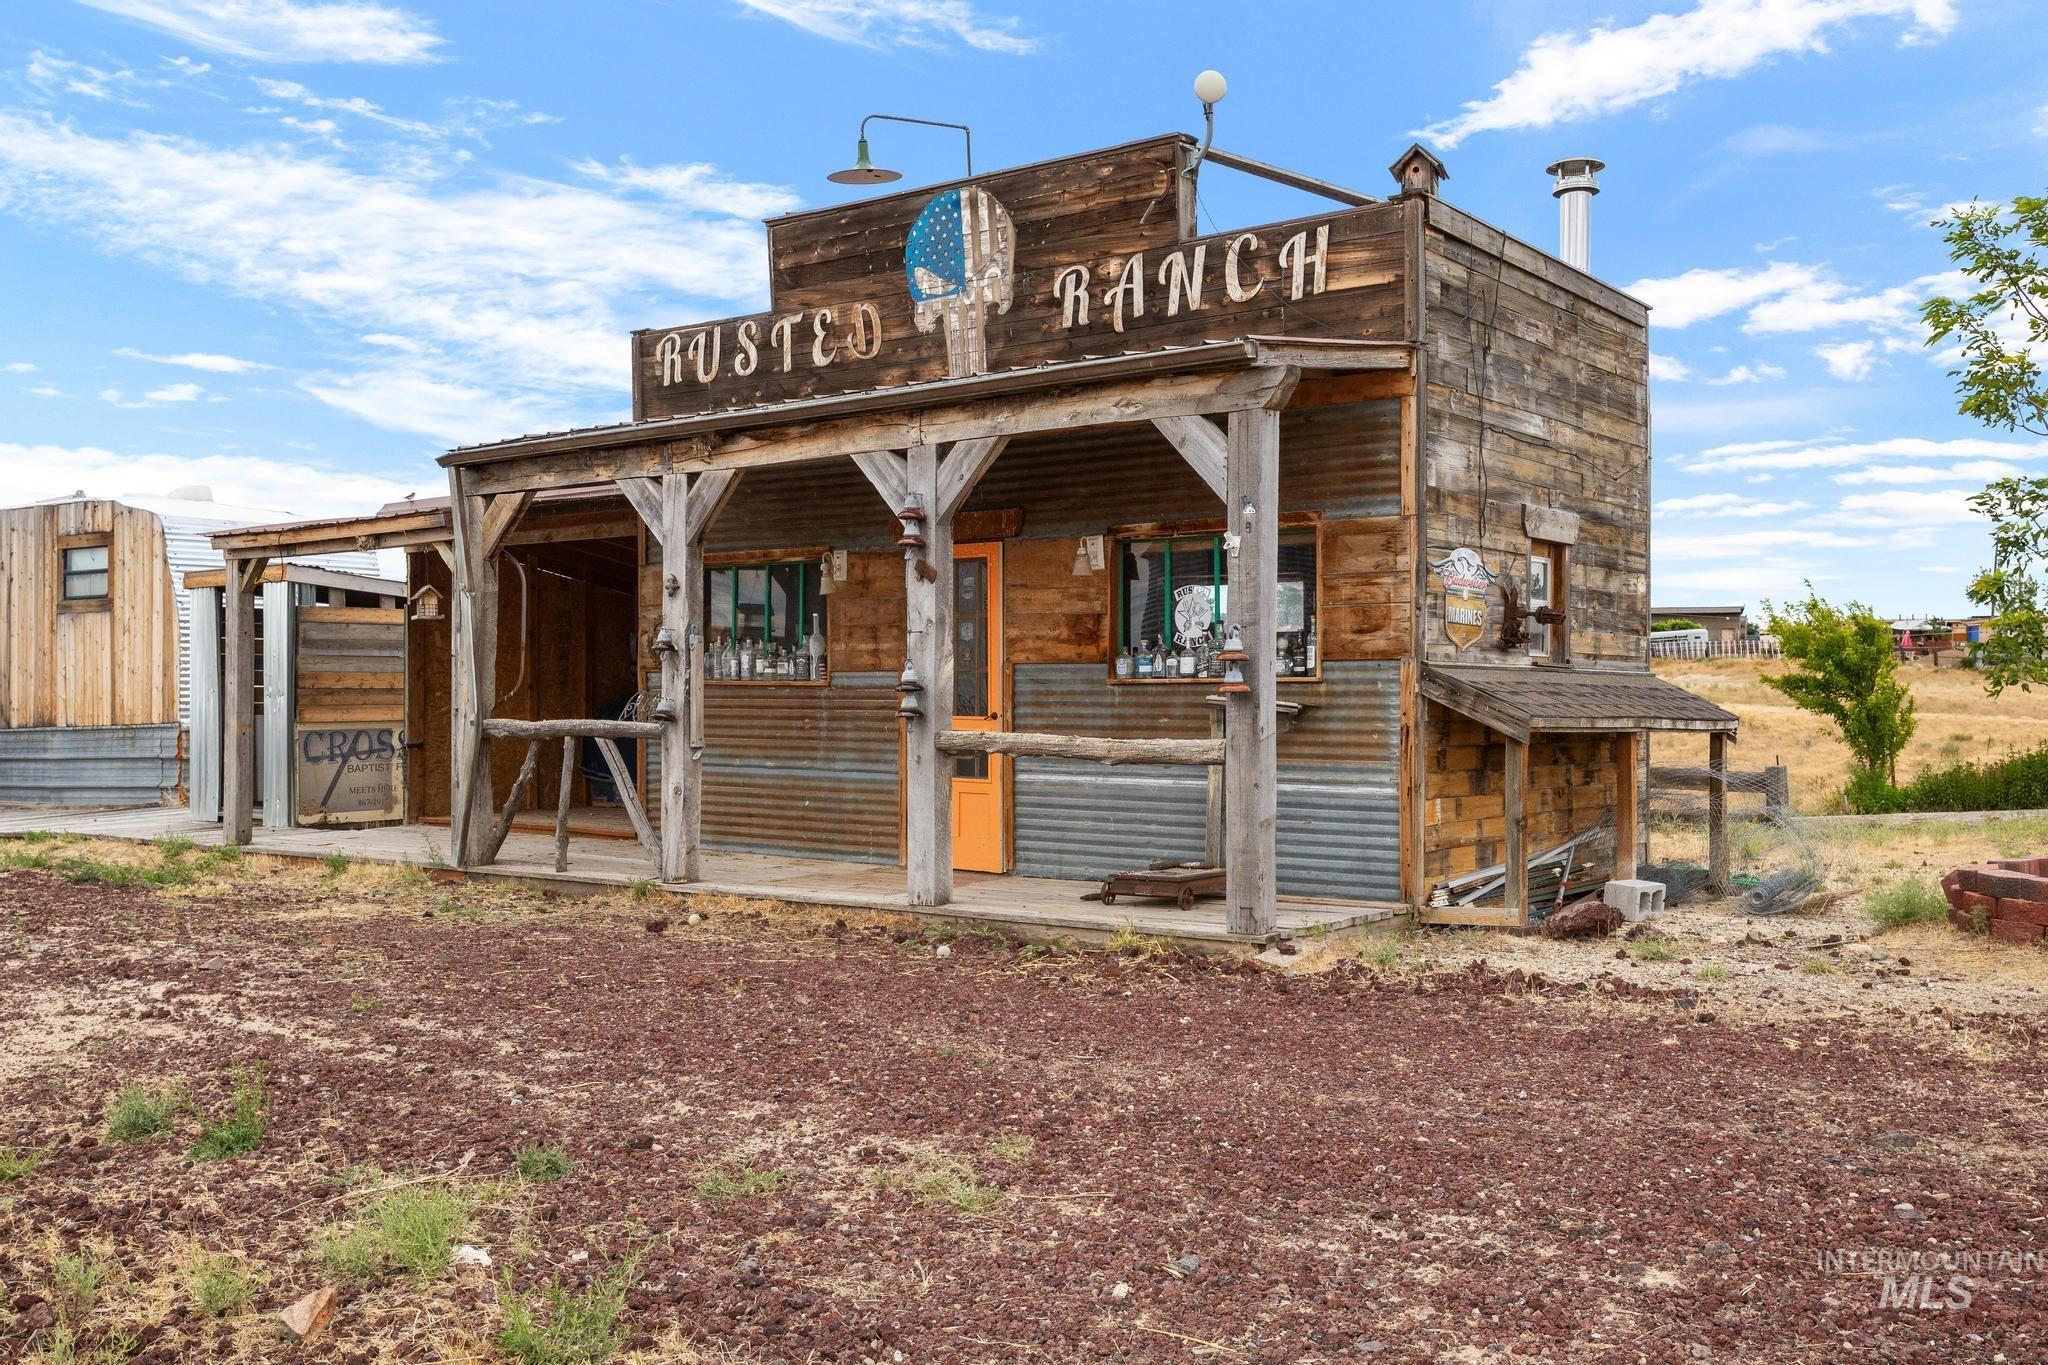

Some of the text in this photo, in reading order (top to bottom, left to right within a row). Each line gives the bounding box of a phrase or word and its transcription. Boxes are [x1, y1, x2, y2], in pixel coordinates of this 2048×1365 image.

[656, 224, 1329, 387] RUSTED RANCH
[1448, 606, 1482, 626] MARINES
[347, 763, 390, 774] BAPTIST
[349, 785, 376, 794] MEETS
